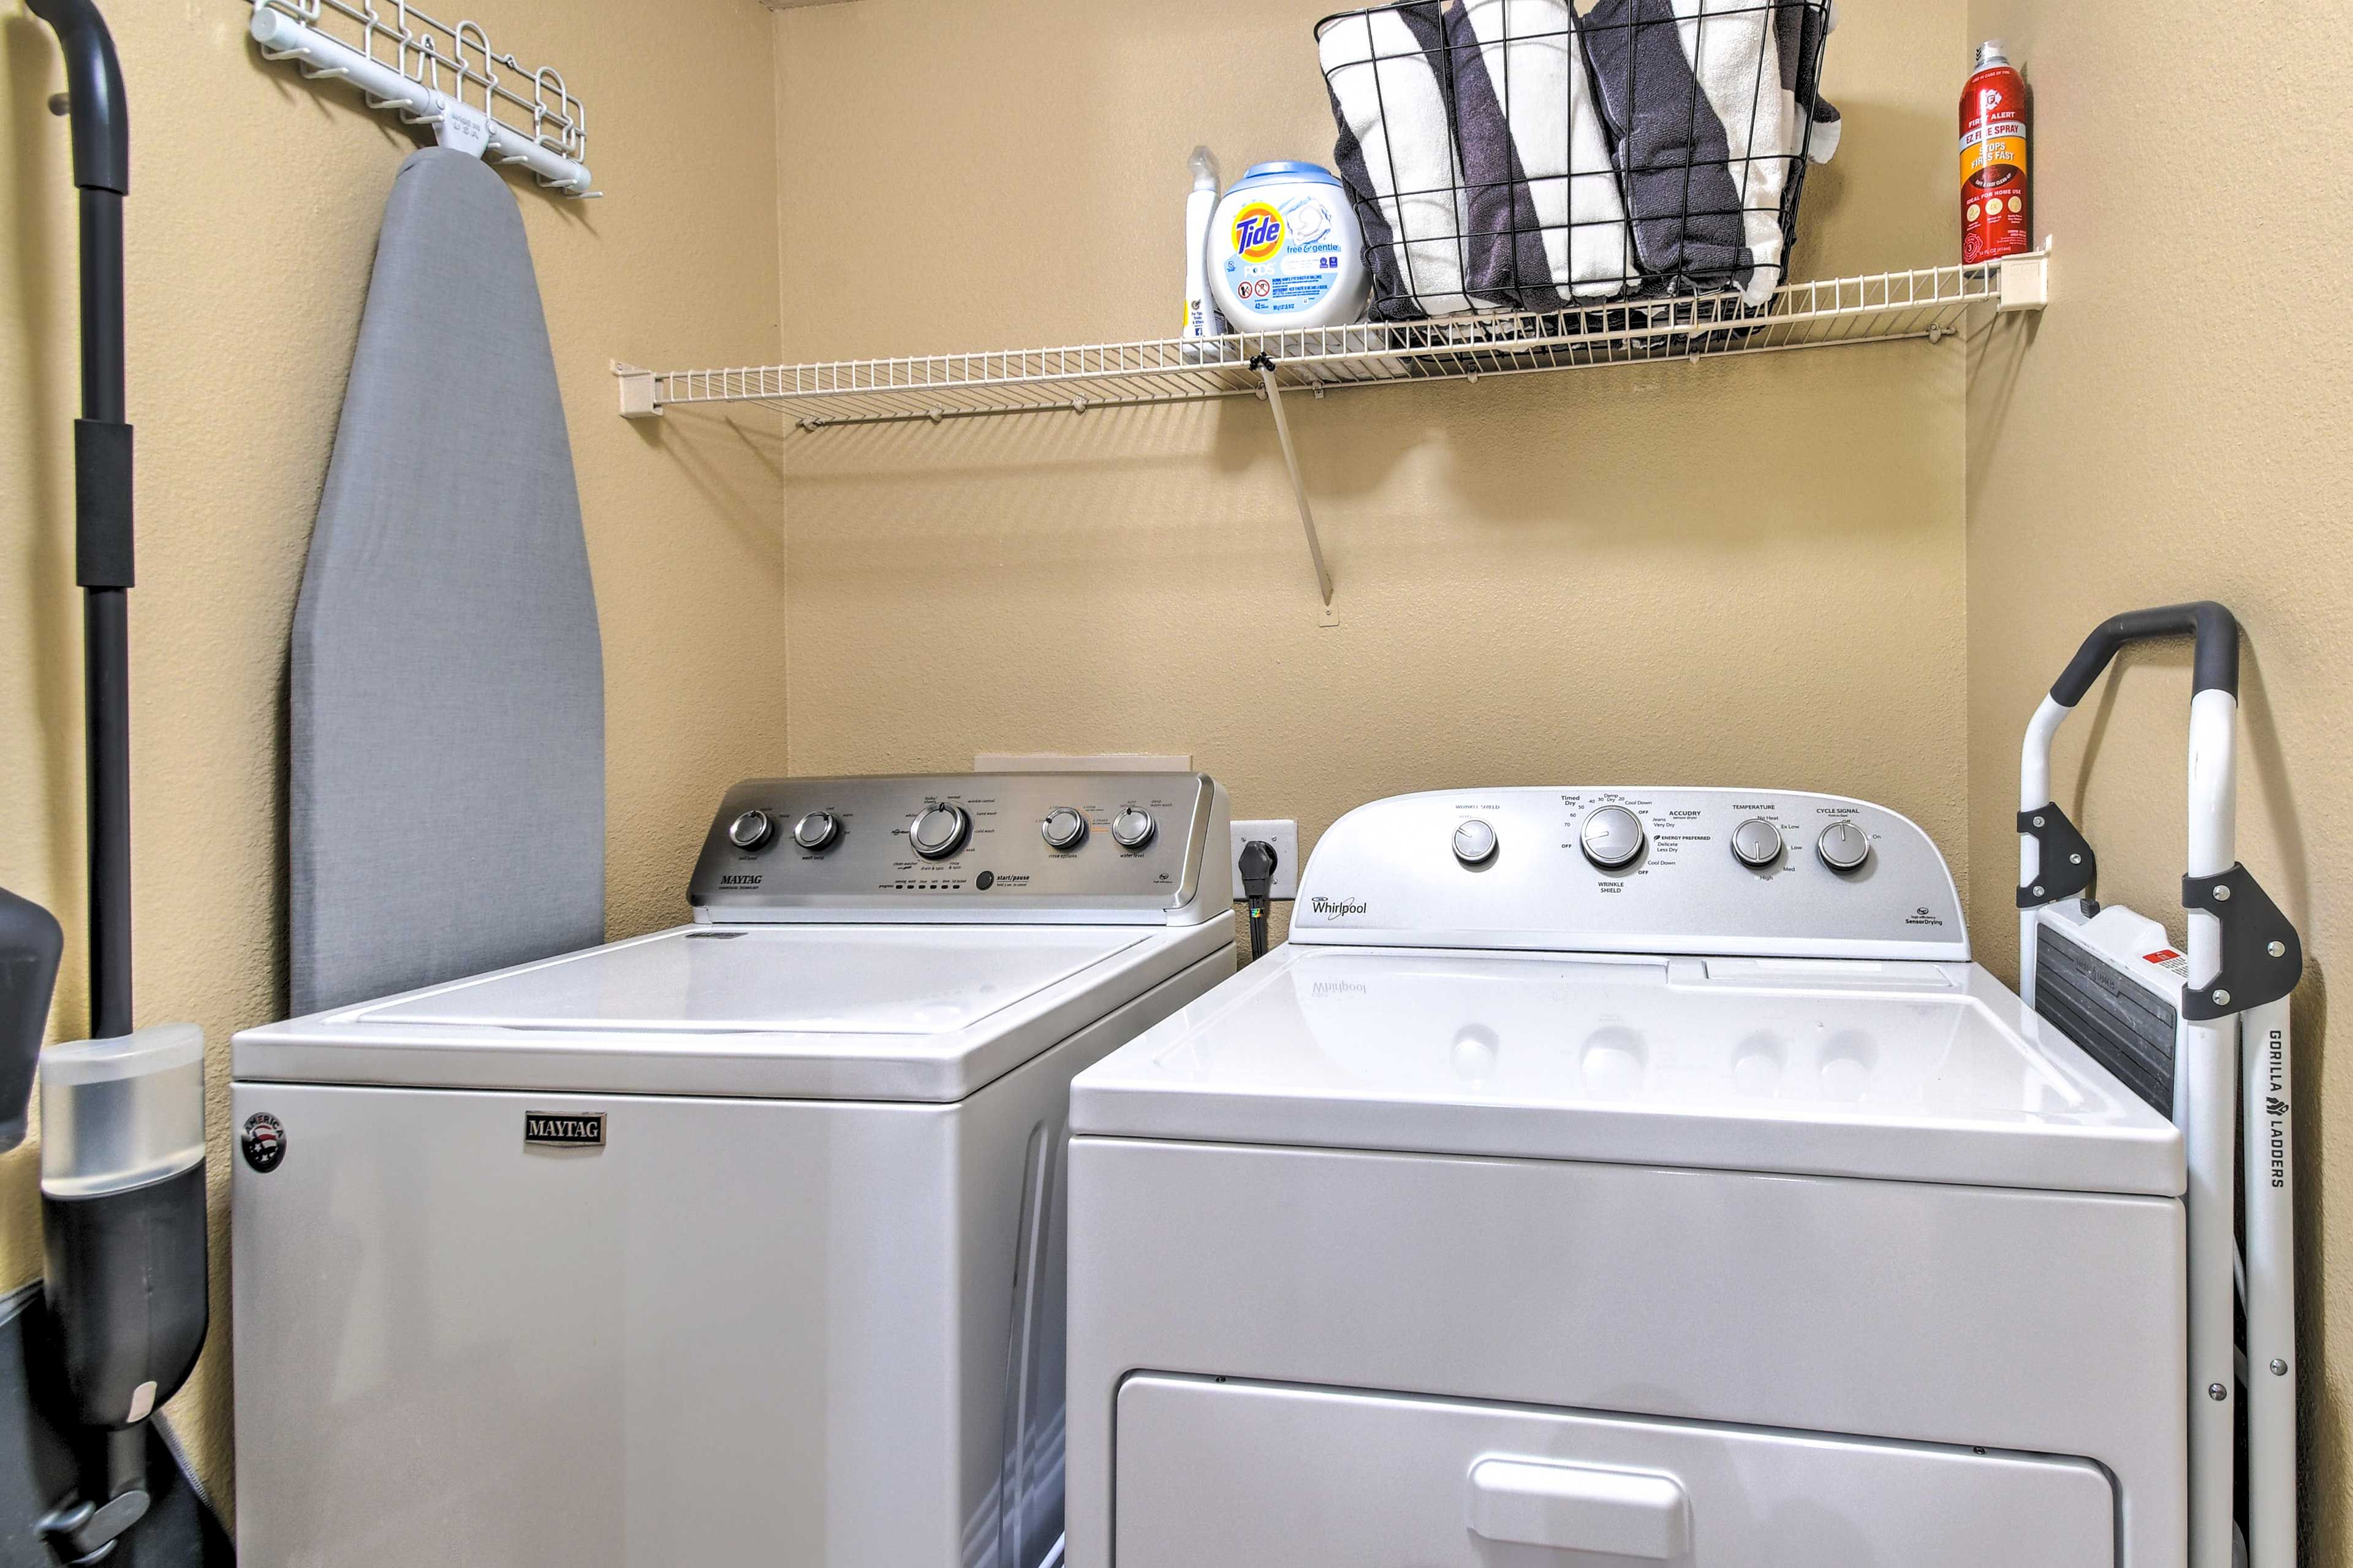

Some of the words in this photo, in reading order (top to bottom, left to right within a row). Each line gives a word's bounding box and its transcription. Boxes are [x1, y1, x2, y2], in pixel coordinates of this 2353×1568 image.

[1991, 112, 2015, 120] ALERT
[1966, 134, 1974, 144] EZ
[1976, 127, 1992, 140] FIE
[1995, 124, 2018, 134] SPRAY
[1995, 151, 2015, 161] FAST
[1966, 196, 1980, 205] IDEAL
[1236, 216, 1280, 254] Tide
[1313, 243, 1338, 253] gentle
[1244, 263, 1275, 278] PODS
[720, 875, 762, 884] MAYTAG
[1313, 902, 1367, 917] Whirlpool
[2270, 1030, 2282, 1092] GORILLA
[245, 1115, 283, 1138] AMERICA
[528, 1120, 599, 1137] MAYTAG
[2271, 1121, 2284, 1188] LADDERS
